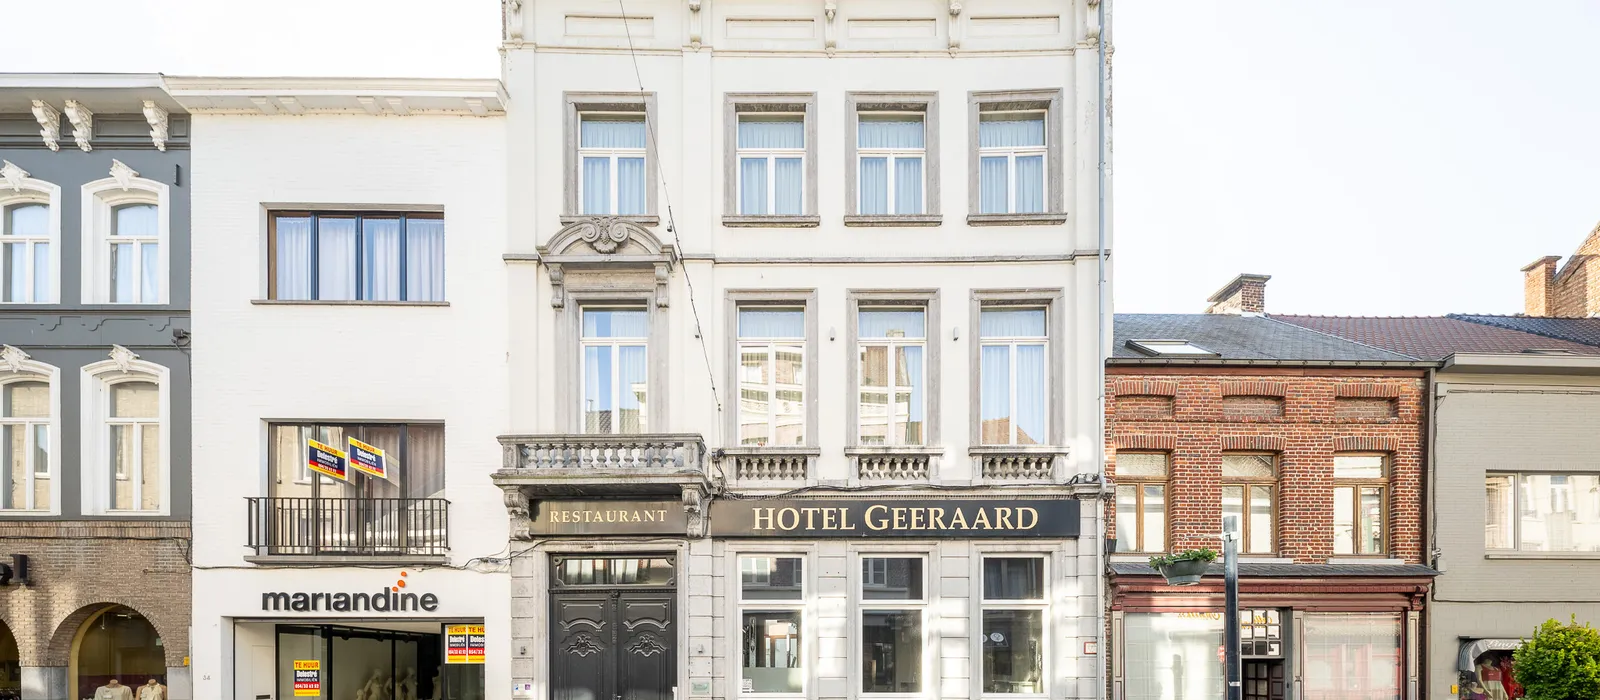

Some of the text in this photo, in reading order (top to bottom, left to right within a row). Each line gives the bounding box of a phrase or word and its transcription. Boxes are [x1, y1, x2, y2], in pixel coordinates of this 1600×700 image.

[324, 445, 337, 454] HUUR
[362, 443, 374, 452] HUUR
[550, 510, 668, 522] RESTAURANT
[752, 504, 1039, 530] HOTEL GEERAARD
[262, 586, 438, 612] mariandine
